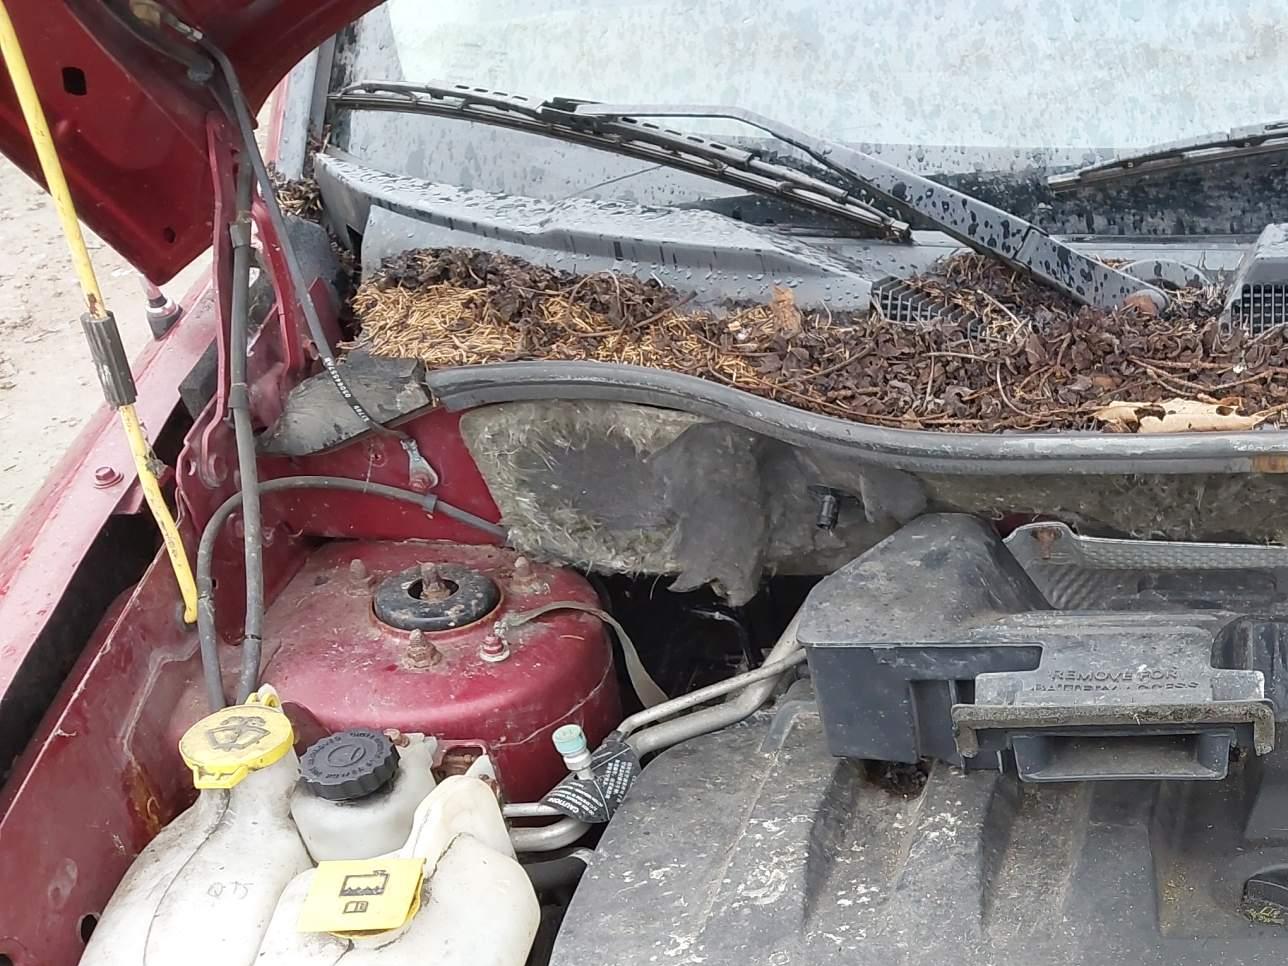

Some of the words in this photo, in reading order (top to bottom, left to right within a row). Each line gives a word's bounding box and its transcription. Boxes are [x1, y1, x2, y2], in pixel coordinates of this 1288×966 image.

[1051, 670, 1133, 682] REMOVE
[1139, 667, 1178, 681] FOR
[547, 797, 580, 814] CAUTION
